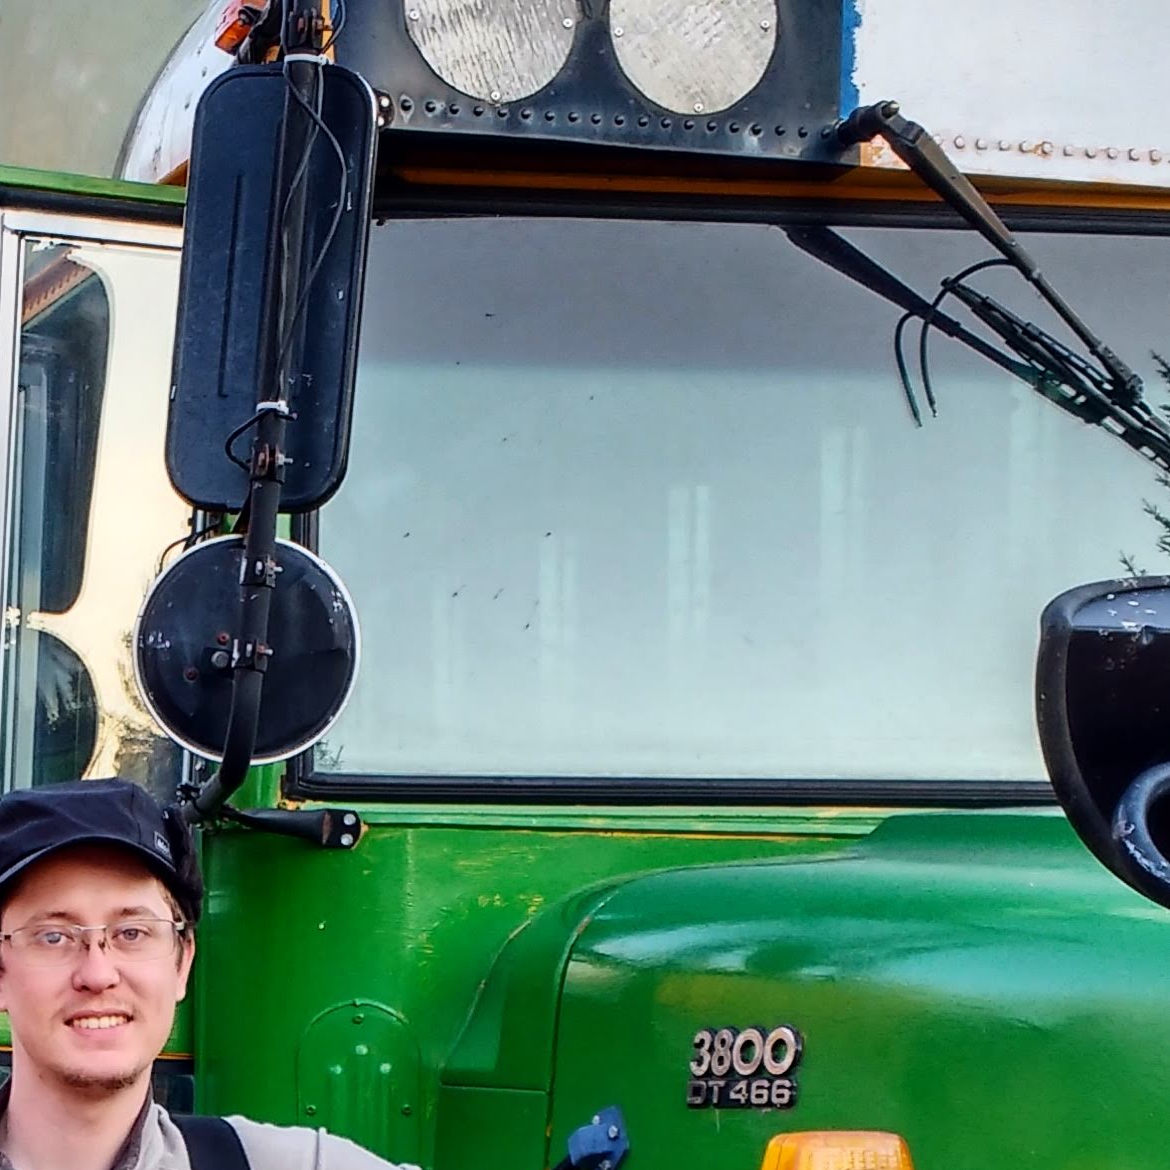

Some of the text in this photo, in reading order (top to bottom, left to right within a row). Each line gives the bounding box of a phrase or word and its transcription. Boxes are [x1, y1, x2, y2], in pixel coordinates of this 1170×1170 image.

[689, 1026, 797, 1077] 3800
[687, 1079, 793, 1105] DT 466
